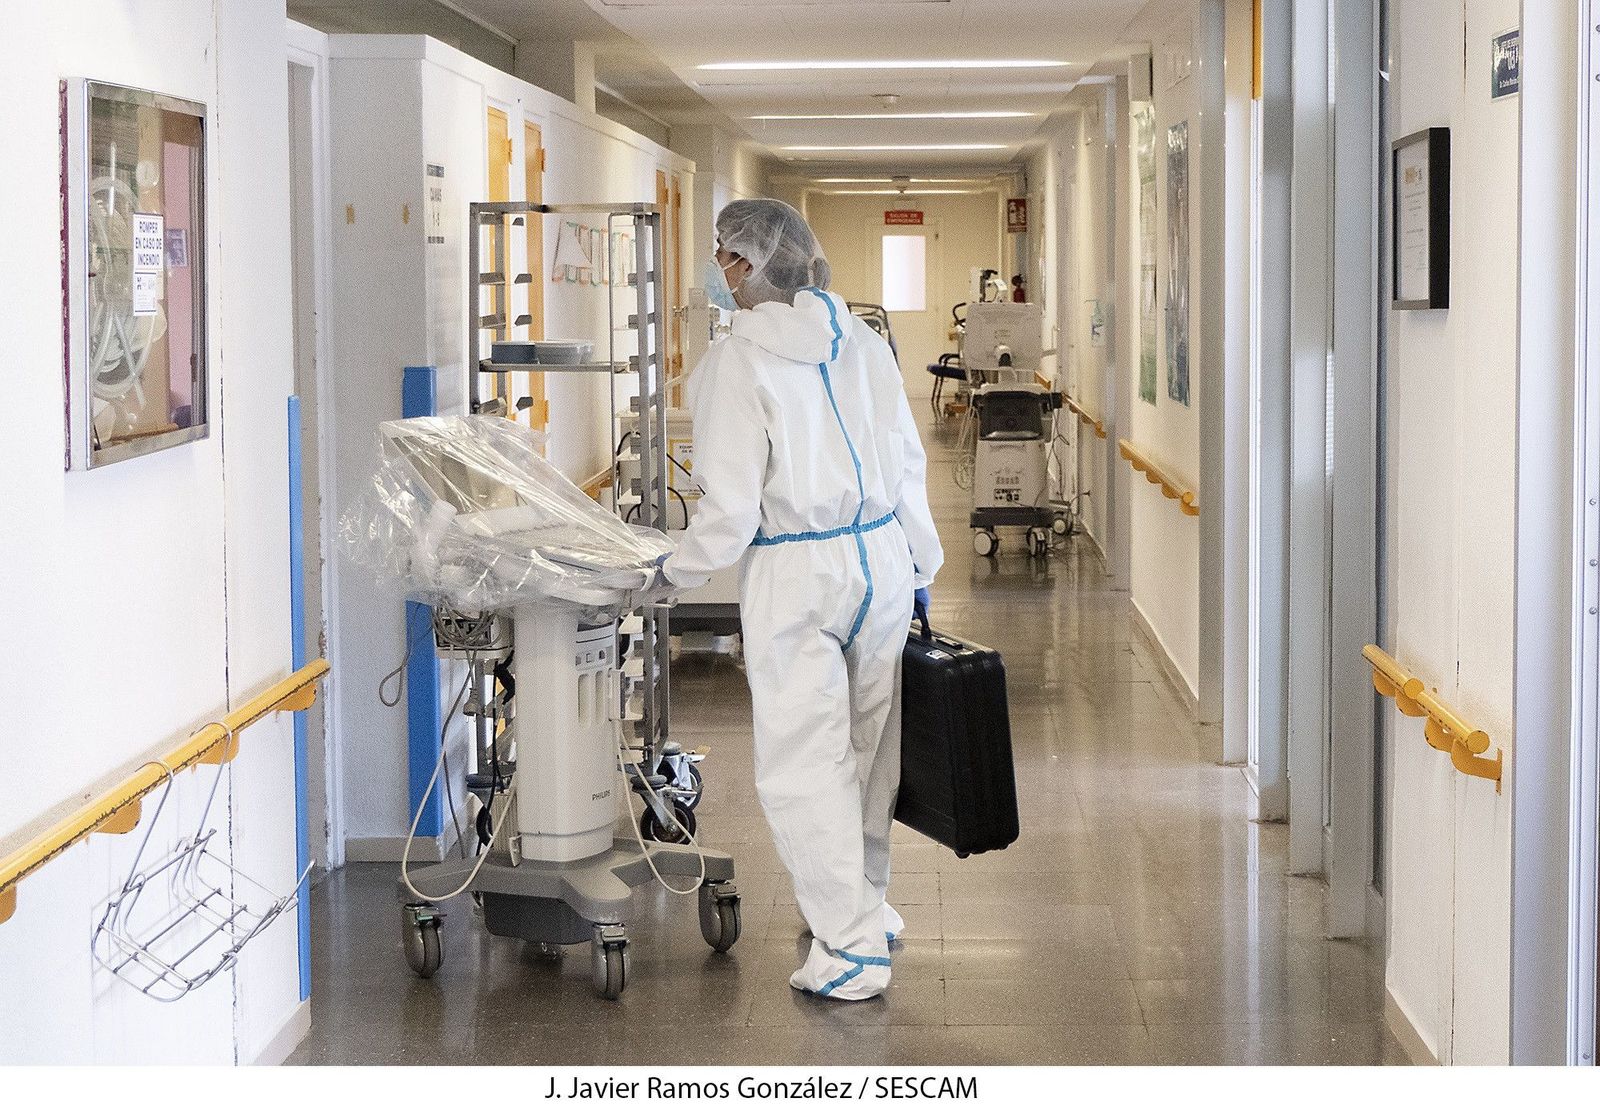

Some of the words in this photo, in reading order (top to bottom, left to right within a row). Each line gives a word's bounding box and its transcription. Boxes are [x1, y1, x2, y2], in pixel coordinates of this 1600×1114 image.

[139, 221, 158, 234] ROMPER
[136, 237, 142, 250] EN
[143, 237, 156, 250] CASO
[156, 238, 162, 250] DE
[138, 254, 160, 266] INCENDIO
[592, 790, 610, 801] PHILIPS
